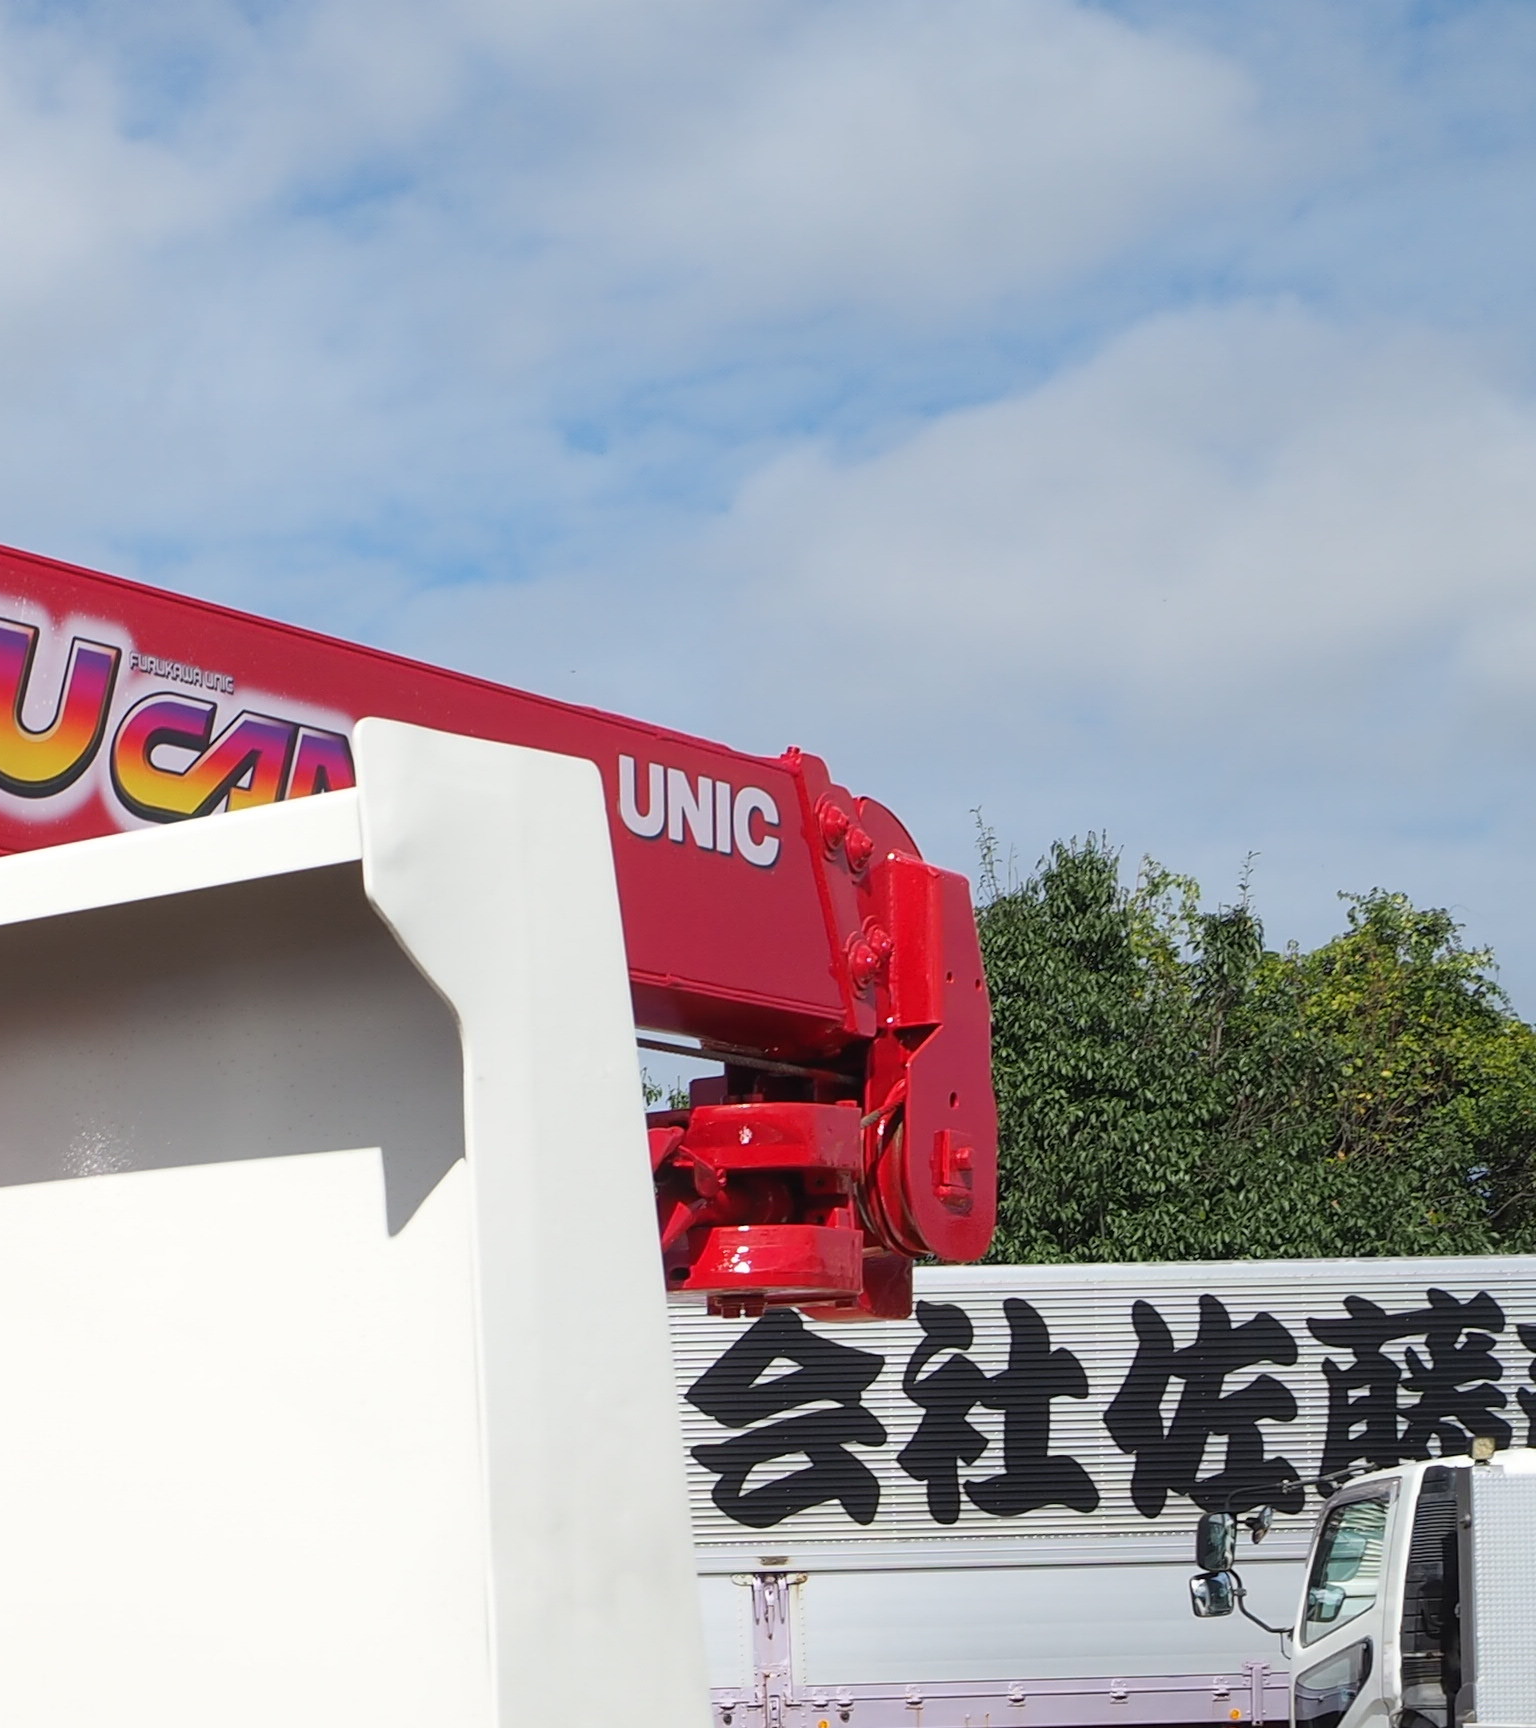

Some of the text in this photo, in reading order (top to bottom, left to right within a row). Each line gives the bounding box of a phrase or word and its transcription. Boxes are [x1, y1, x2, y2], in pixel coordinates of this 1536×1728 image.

[128, 650, 235, 695] FURUKAWA UNIC
[619, 754, 780, 867] UNIC
[683, 1289, 1536, 1525] 会社佐藤
